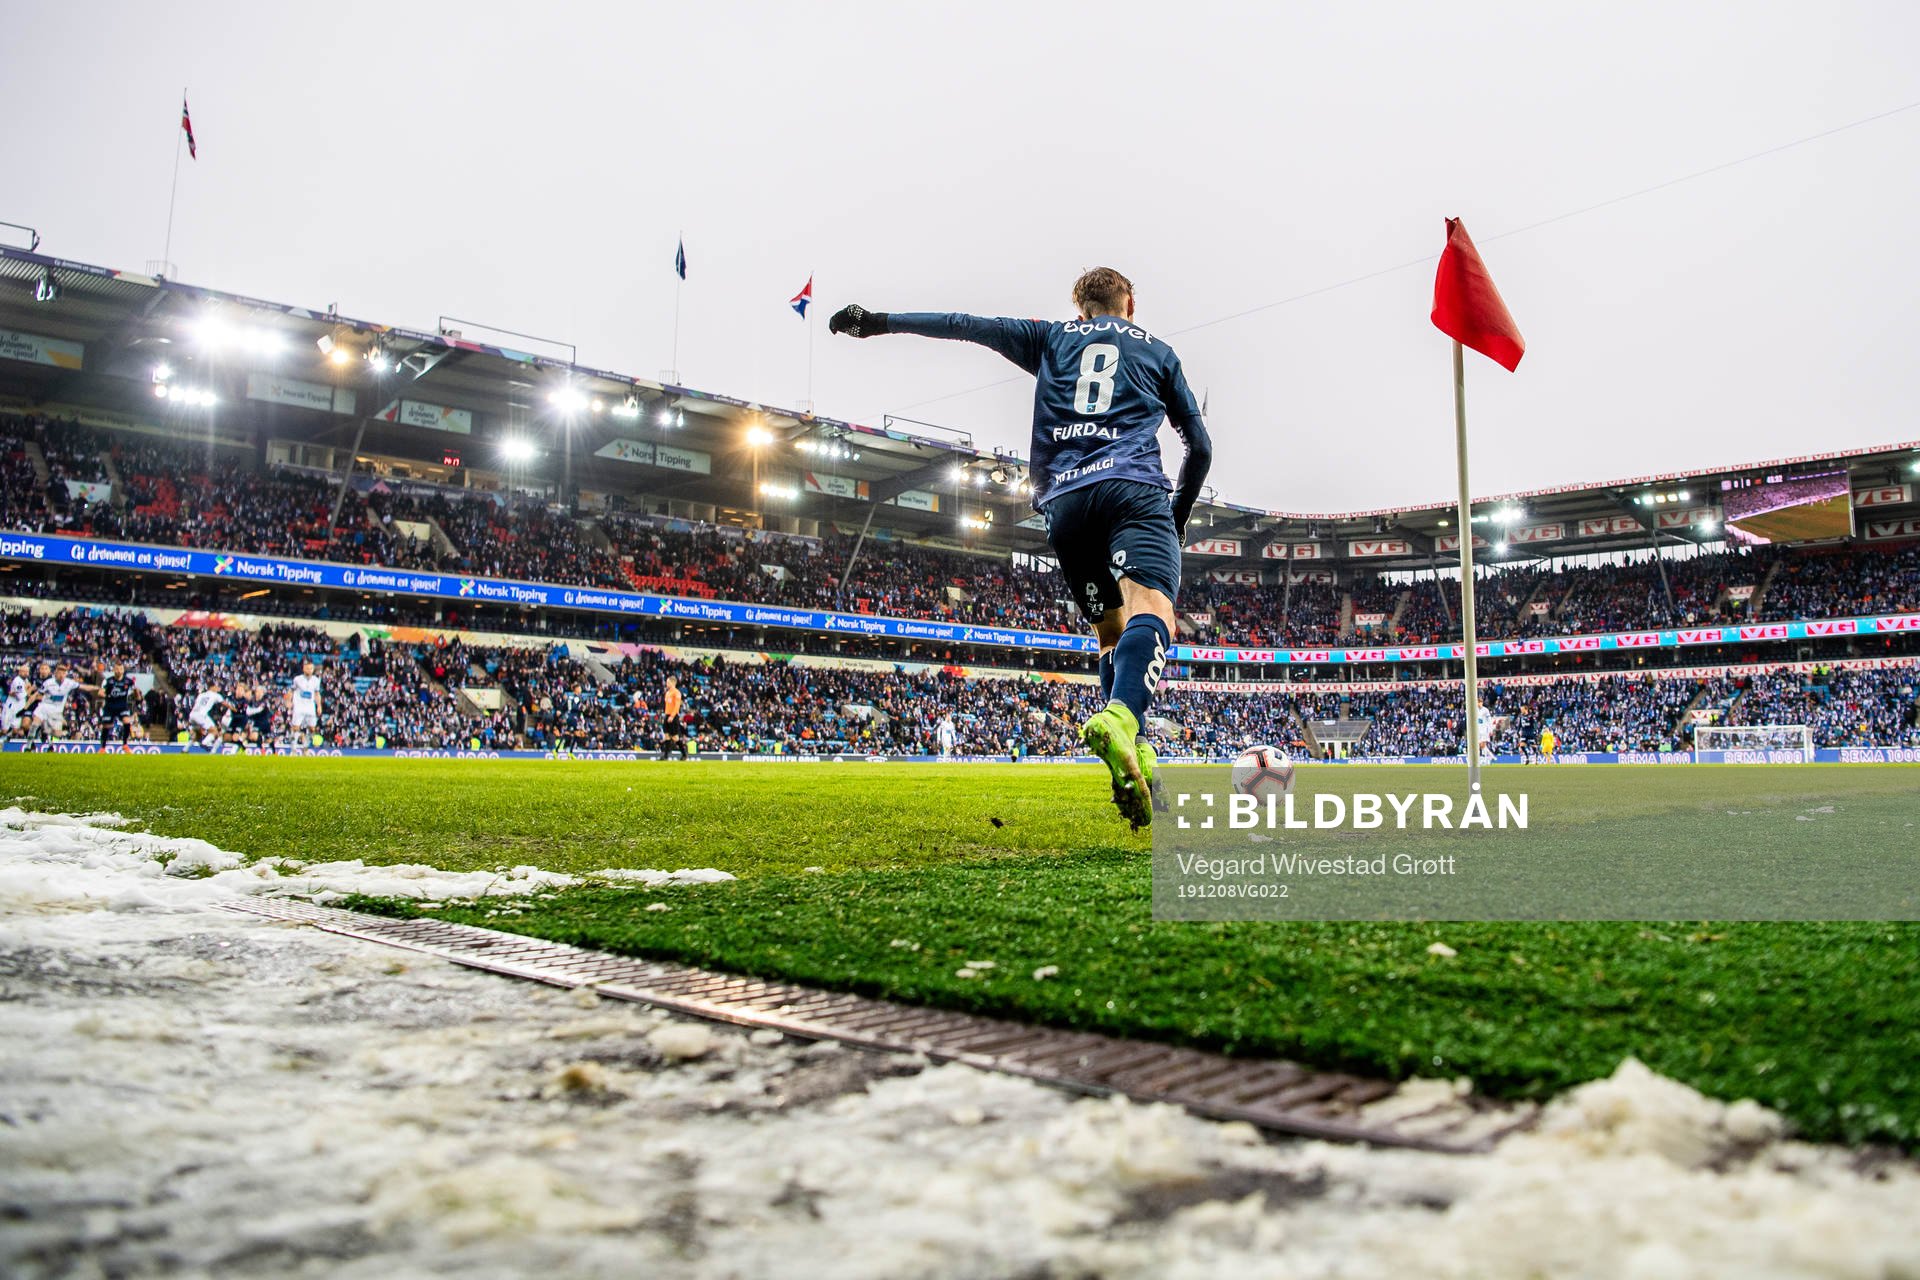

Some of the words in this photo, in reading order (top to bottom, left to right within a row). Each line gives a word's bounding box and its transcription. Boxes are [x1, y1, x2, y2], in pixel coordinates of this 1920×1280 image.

[1074, 343, 1119, 415] 8
[1053, 423, 1121, 442] FURDAL
[632, 447, 657, 459] Nors
[659, 452, 691, 468] Tipping
[1585, 518, 1637, 534] VG
[1510, 527, 1557, 543] VG
[1193, 541, 1236, 554] VG
[1270, 545, 1315, 557] VG
[1355, 542, 1406, 555] VG
[71, 544, 85, 560] Gi
[88, 545, 136, 563] drømmen
[138, 552, 151, 564] en
[153, 553, 192, 570] sjanse!
[237, 561, 274, 576] Norsk
[276, 564, 322, 583] Tipping
[343, 570, 355, 584] Gi
[1211, 571, 1257, 584] VG
[1284, 571, 1332, 584] VG
[478, 584, 508, 598] Norsk
[510, 587, 547, 603] Tipping
[674, 602, 700, 615] Norsk
[701, 605, 732, 620] Tipping
[837, 618, 859, 629] Norsk
[860, 620, 886, 633] Tipping
[1807, 622, 1857, 635] VG
[1877, 617, 1920, 632] VG
[974, 632, 992, 640] Norsk
[993, 632, 1015, 644] Tipping
[1678, 630, 1721, 643] VG
[1741, 626, 1787, 639] VG
[1560, 638, 1600, 650] VG
[1617, 634, 1659, 647] VG
[1400, 648, 1438, 659] VG
[1504, 641, 1543, 654] VG
[1193, 650, 1224, 659] VG
[1238, 651, 1275, 661] VG
[1290, 652, 1330, 662] VG
[1346, 650, 1384, 661] VG
[1841, 660, 1874, 670] VG
[1880, 658, 1915, 668] VG
[1658, 670, 1687, 678] VG
[1692, 668, 1722, 677] VG
[1728, 666, 1759, 675] VG
[1200, 682, 1223, 690] VG
[1528, 676, 1554, 684] VG
[1227, 683, 1250, 691] VG
[1256, 683, 1281, 691] VG
[1286, 683, 1311, 691] VG
[1316, 683, 1342, 691] VG
[1348, 683, 1373, 691] VG
[1378, 683, 1404, 691] VG
[1559, 755, 1588, 764] 1000
[1618, 753, 1657, 764] REMA
[1660, 753, 1691, 764] 1000
[1724, 751, 1766, 763] REMA
[1769, 751, 1802, 763] 1000
[1840, 750, 1884, 762] REMA
